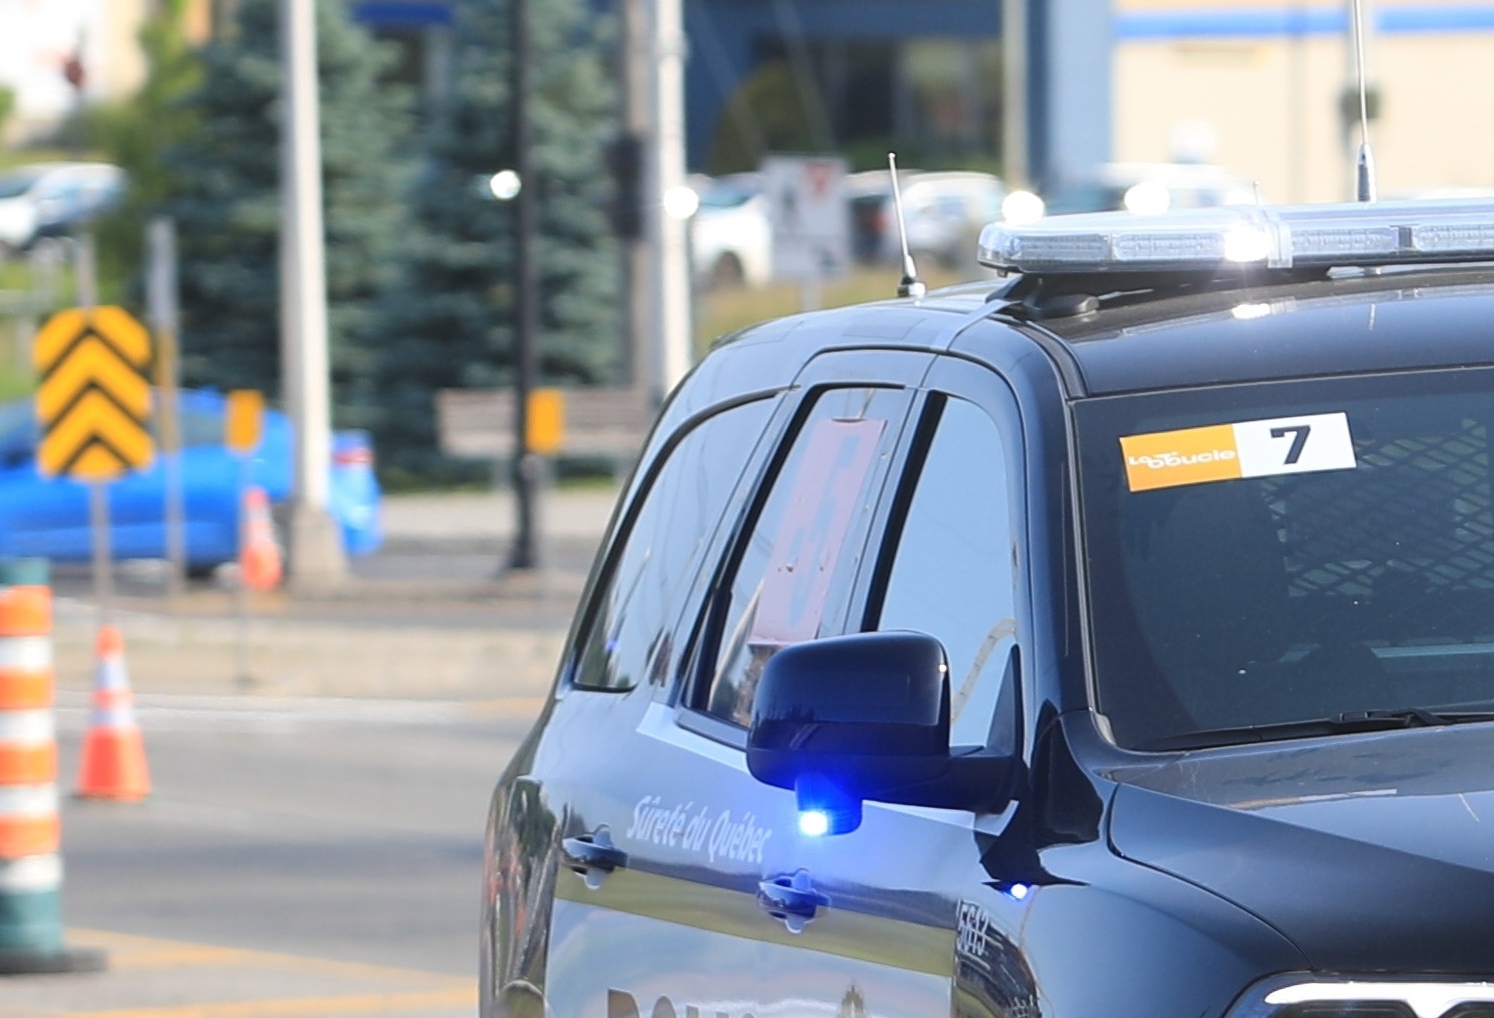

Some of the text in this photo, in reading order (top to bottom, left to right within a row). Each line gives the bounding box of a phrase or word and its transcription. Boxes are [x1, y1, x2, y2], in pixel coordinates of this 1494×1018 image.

[1269, 424, 1311, 466] 7
[626, 795, 773, 864] Sûreté du Québec
